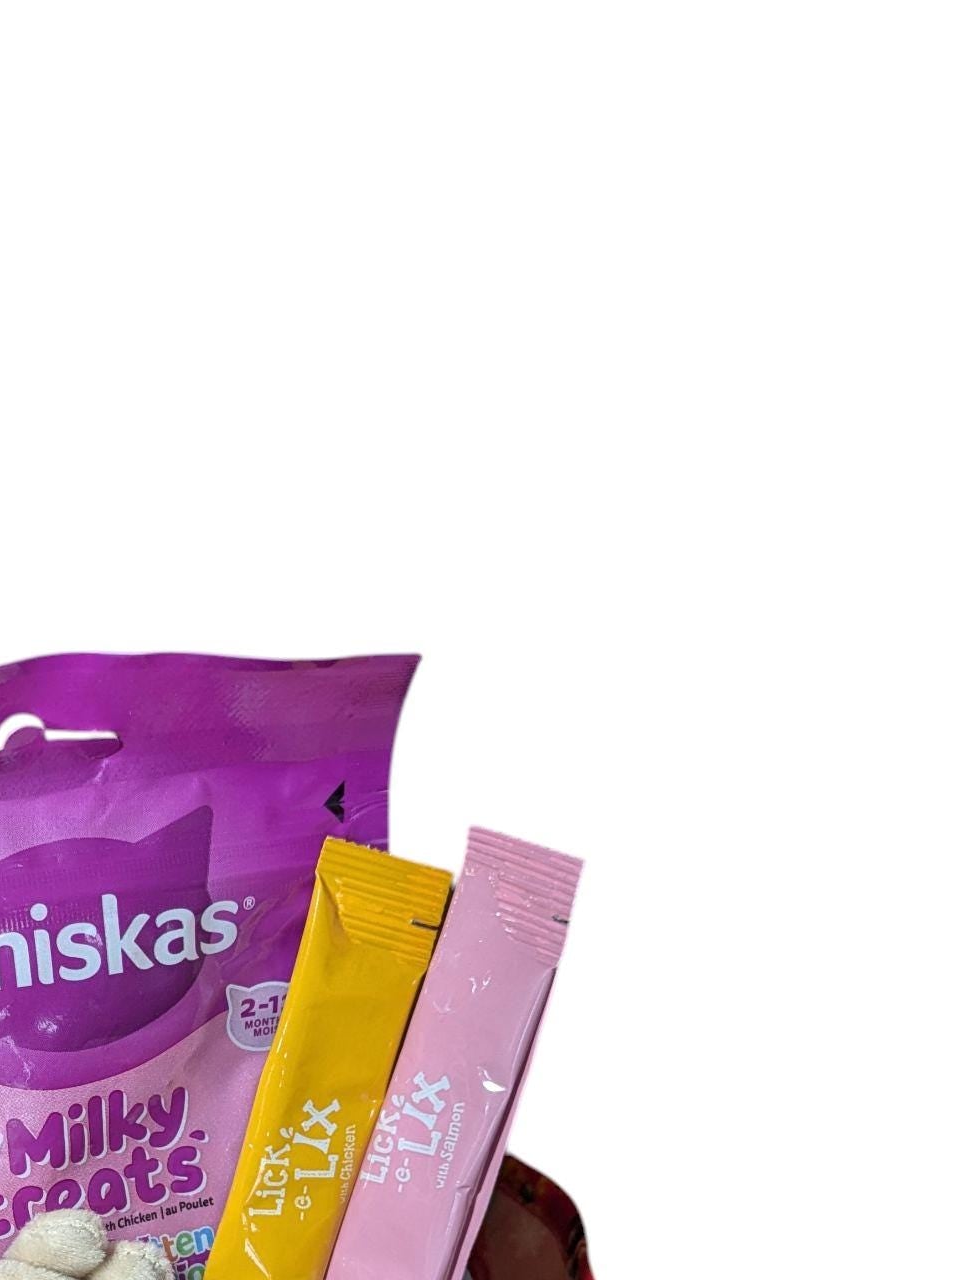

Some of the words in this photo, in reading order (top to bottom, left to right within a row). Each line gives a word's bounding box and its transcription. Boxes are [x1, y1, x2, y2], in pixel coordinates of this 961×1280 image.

[7, 1087, 189, 1179] Milky
[339, 1124, 357, 1180] Chicken
[440, 1101, 466, 1161] Salmon
[435, 1162, 450, 1190] with
[117, 1211, 158, 1230] Chicken
[166, 1206, 178, 1217] au
[179, 1196, 214, 1213] Poulet
